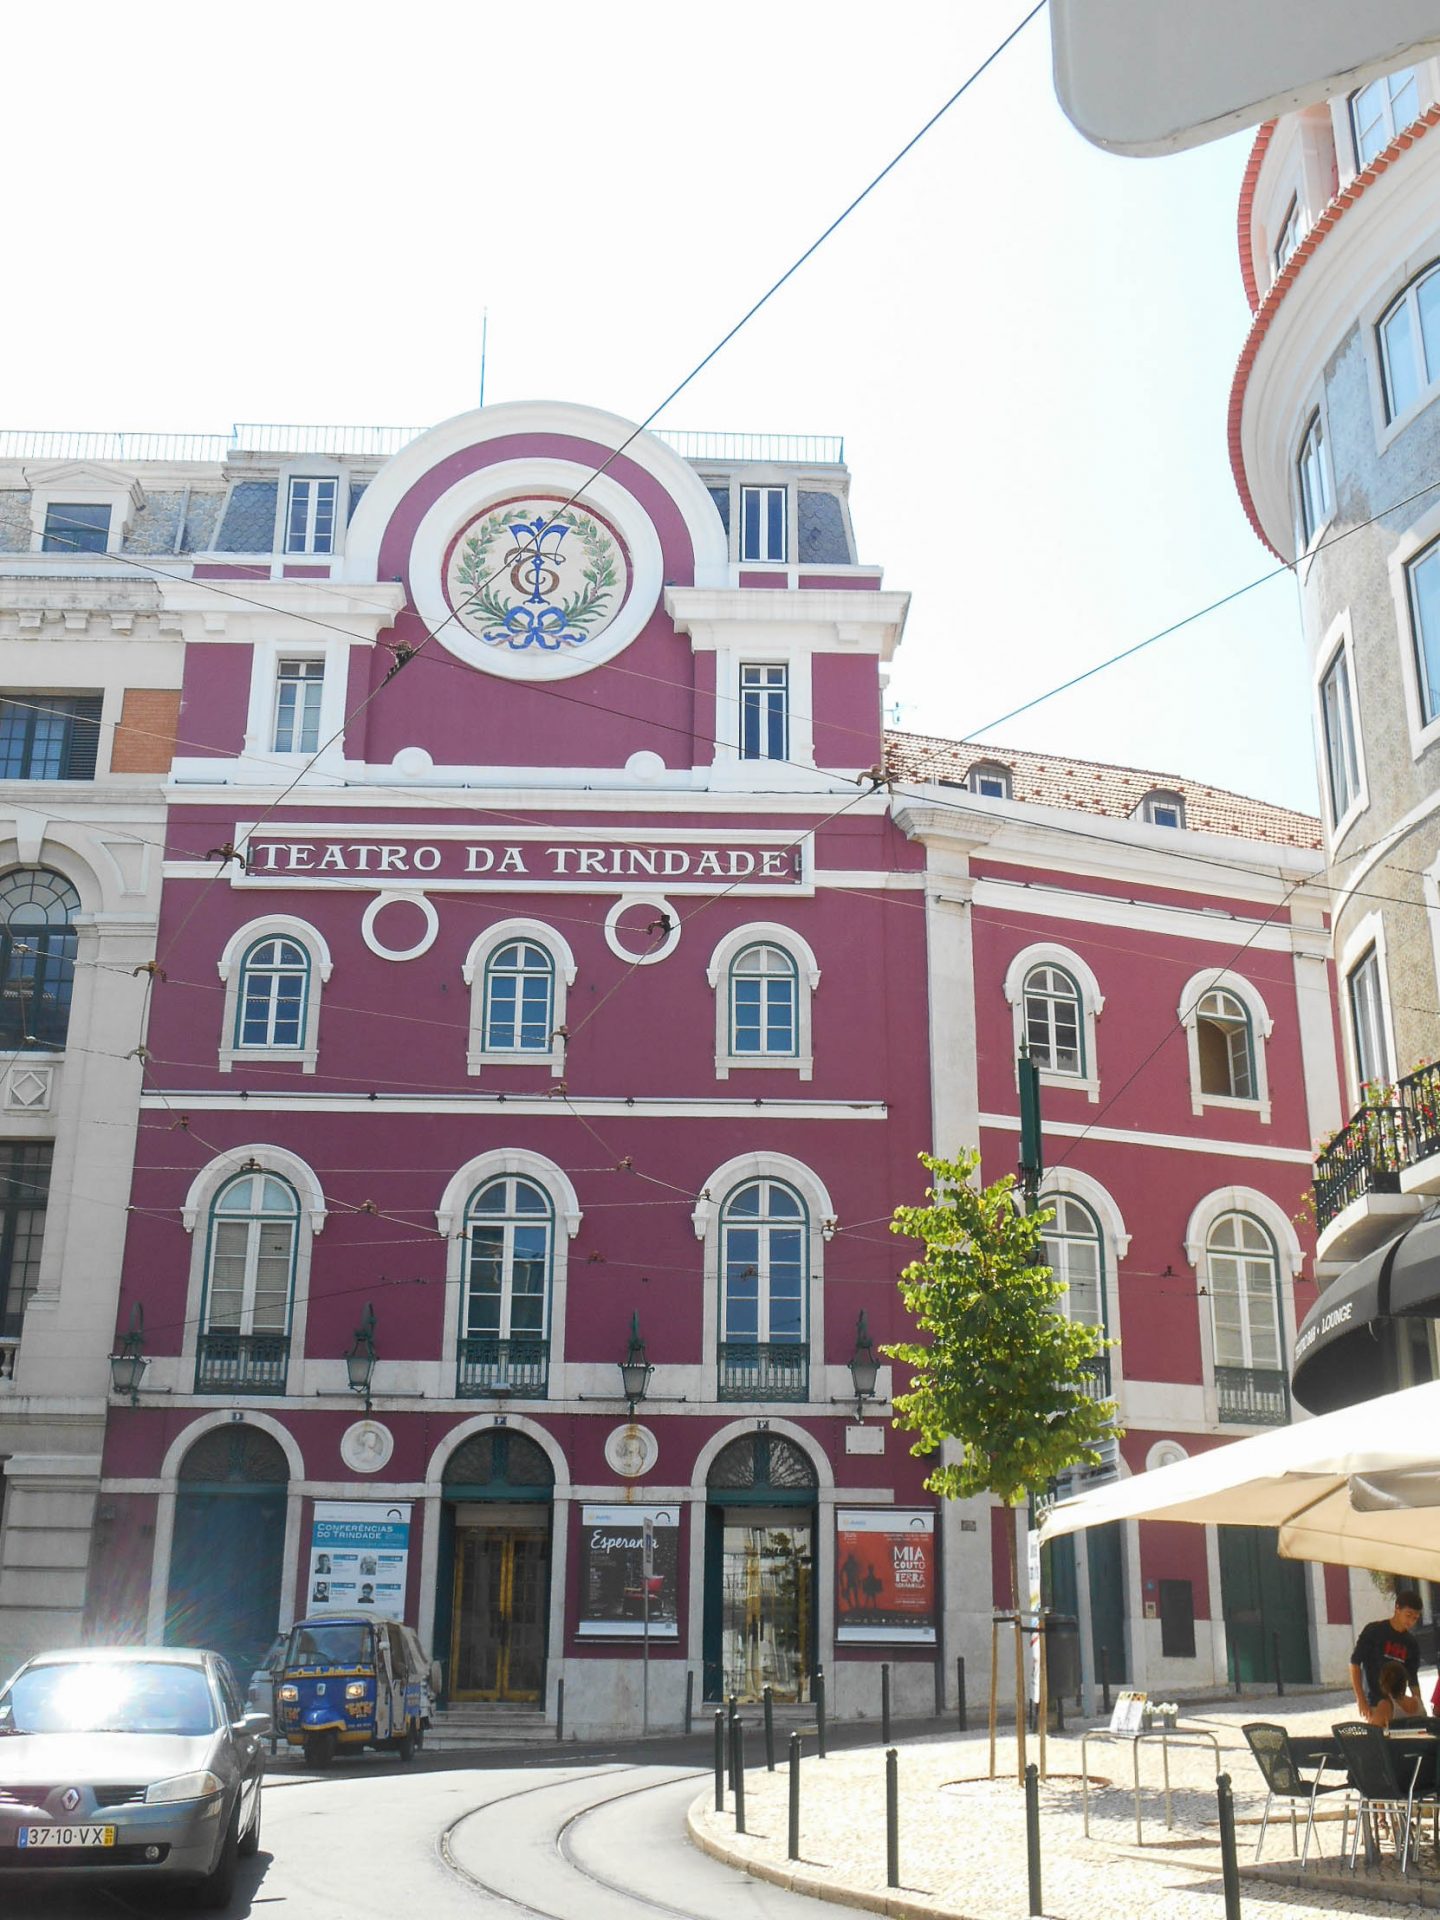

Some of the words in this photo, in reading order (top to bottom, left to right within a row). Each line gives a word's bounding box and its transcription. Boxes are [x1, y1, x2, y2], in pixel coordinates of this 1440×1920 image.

[256, 844, 442, 872] TEATRO
[465, 847, 530, 874] DA
[545, 848, 789, 877] TRINDADE
[1321, 1302, 1353, 1335] LOUNGE
[317, 1531, 332, 1539] DO
[334, 1531, 381, 1540] TRINDADE
[590, 1529, 659, 1554] Esperana
[893, 1546, 925, 1561] MIA
[894, 1562, 926, 1570] COUTO
